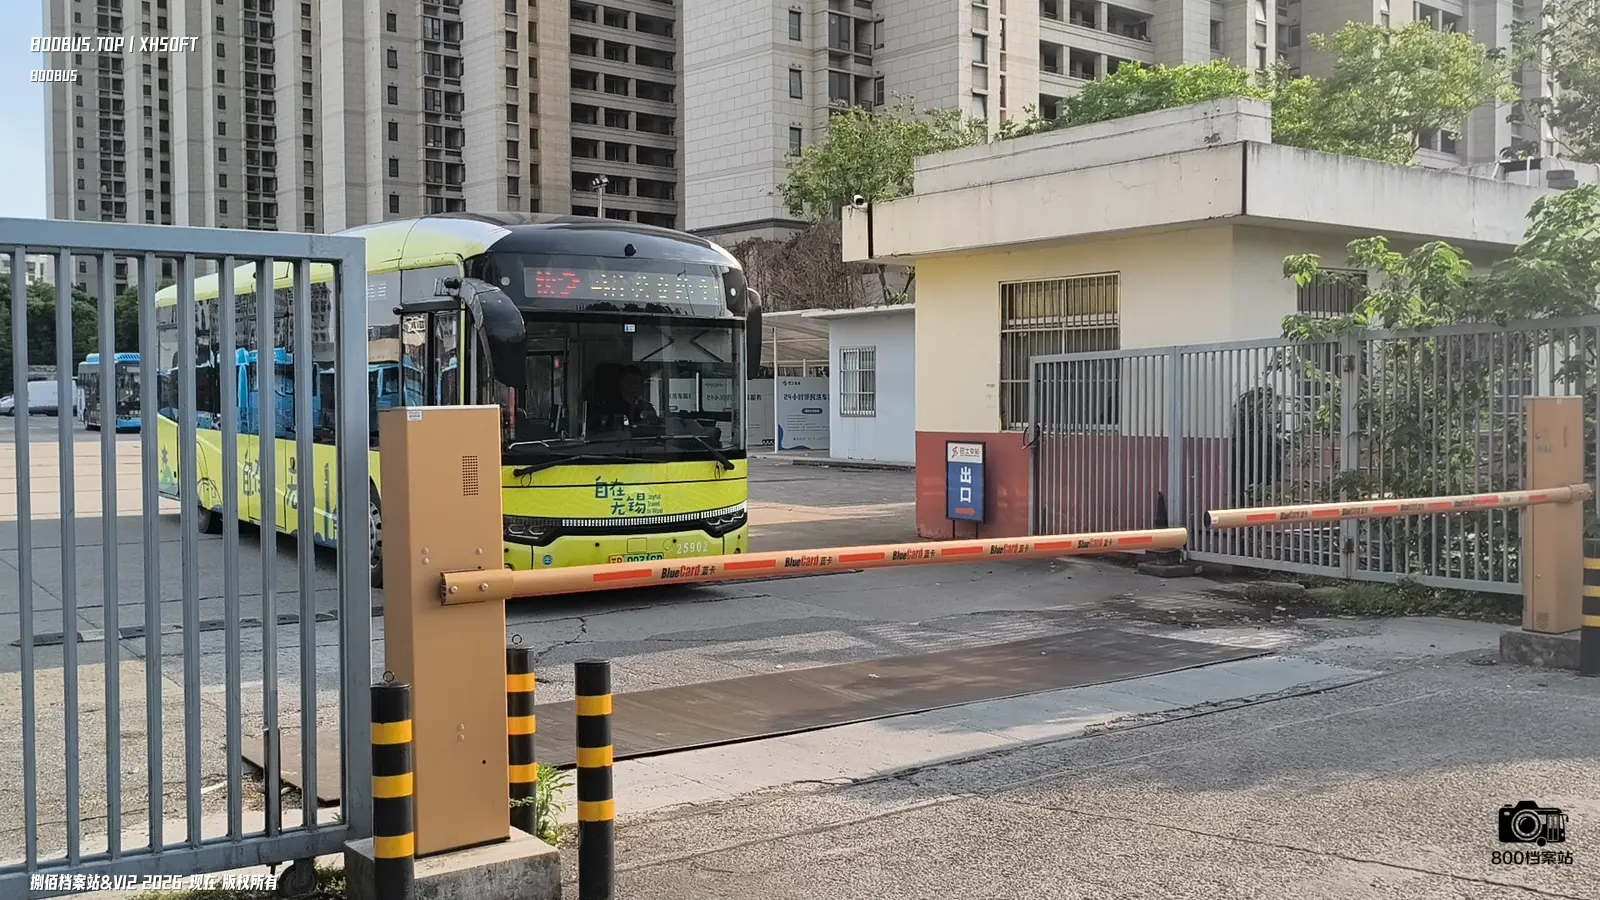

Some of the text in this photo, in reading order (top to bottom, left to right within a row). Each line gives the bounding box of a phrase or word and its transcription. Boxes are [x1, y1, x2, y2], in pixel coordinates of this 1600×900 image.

[595, 476, 625, 499] 自在
[960, 466, 972, 503] 出口
[610, 493, 646, 515] 无锡
[676, 541, 708, 554] 25902
[892, 548, 923, 560] BlueCard
[990, 543, 1018, 555] BlueCard
[784, 555, 819, 567] BlueCard
[661, 565, 700, 579] BlueCard
